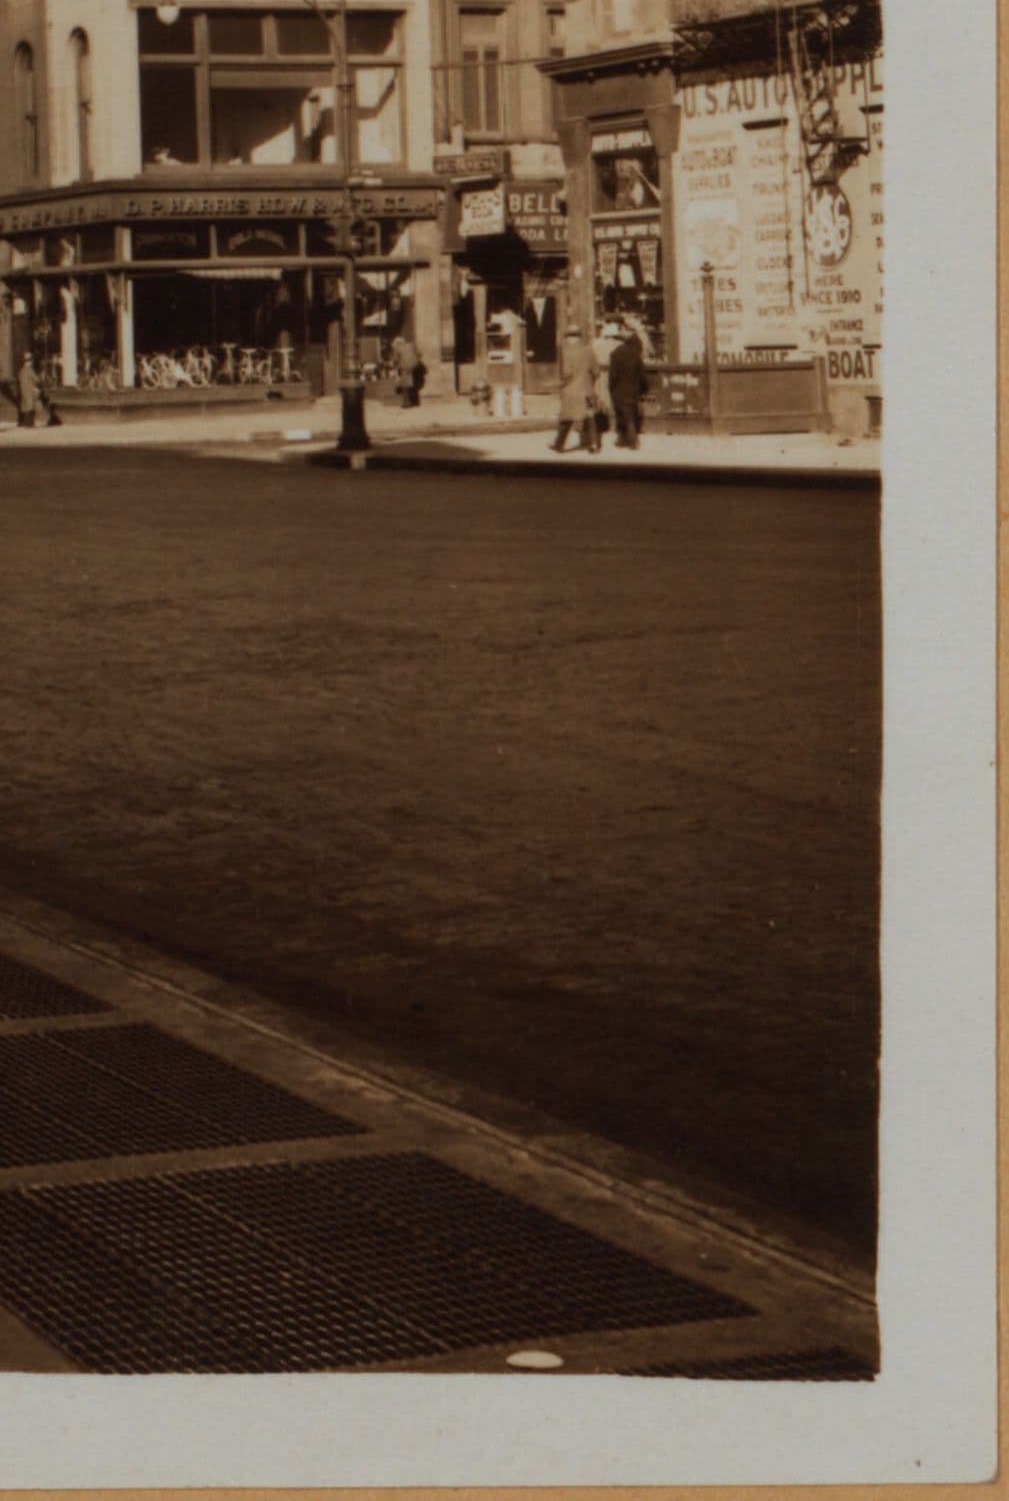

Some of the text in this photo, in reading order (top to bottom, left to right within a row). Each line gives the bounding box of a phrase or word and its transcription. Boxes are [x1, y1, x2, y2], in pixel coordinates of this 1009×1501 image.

[726, 75, 787, 112] AUTO
[169, 197, 250, 216] HARRIS
[690, 277, 737, 291] TES
[836, 289, 862, 304] 1910
[697, 298, 743, 314] TBES
[692, 350, 790, 367] AOMOBILE
[827, 350, 874, 379] BOAT
